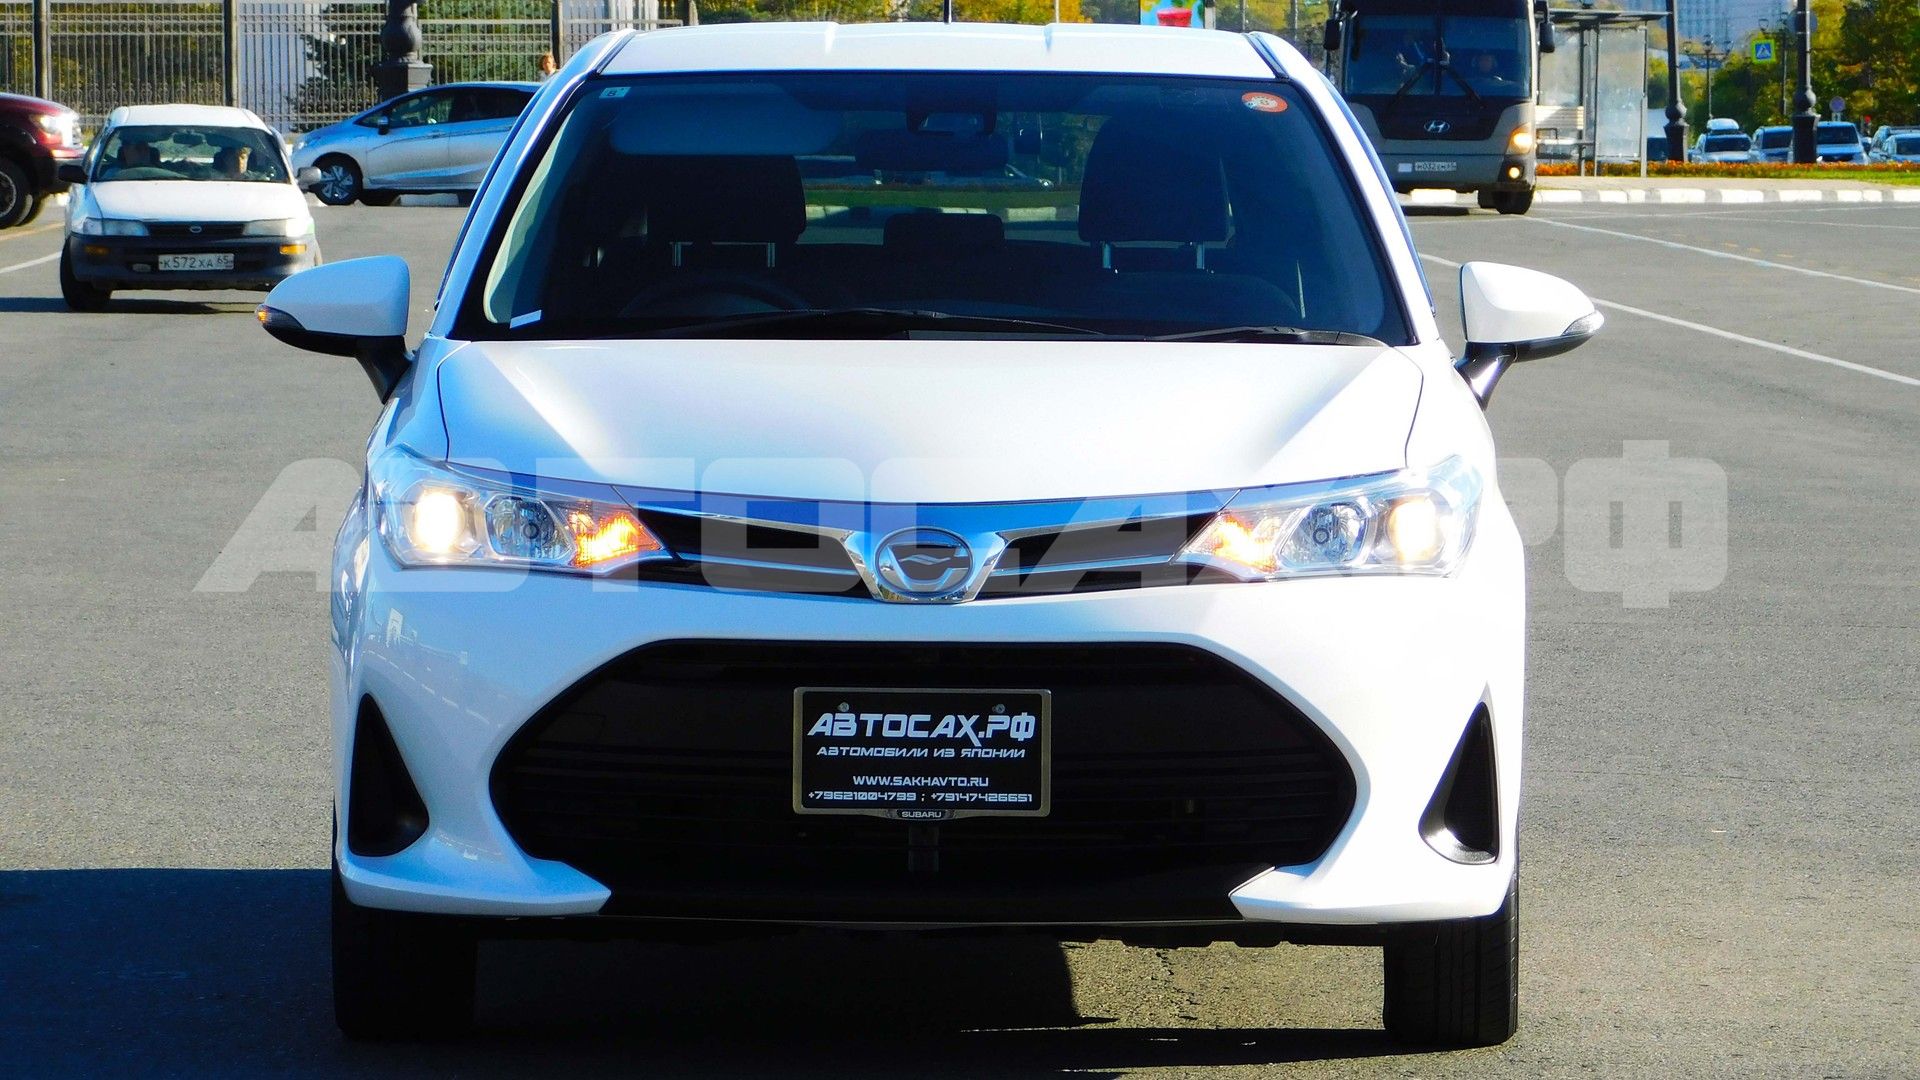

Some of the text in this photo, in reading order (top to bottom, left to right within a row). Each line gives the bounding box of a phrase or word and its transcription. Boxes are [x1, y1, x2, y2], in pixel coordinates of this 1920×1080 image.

[807, 711, 1036, 747] АВТОСАХ.РФ
[816, 746, 1026, 759] АВТОМОБИЛИ ИЗ ЯПОНИИ
[852, 775, 989, 787] WWW.SAKHAVTO.RU
[808, 791, 917, 801] +79621004799
[930, 792, 1033, 803] +79147426651
[901, 810, 942, 819] SUBARU
